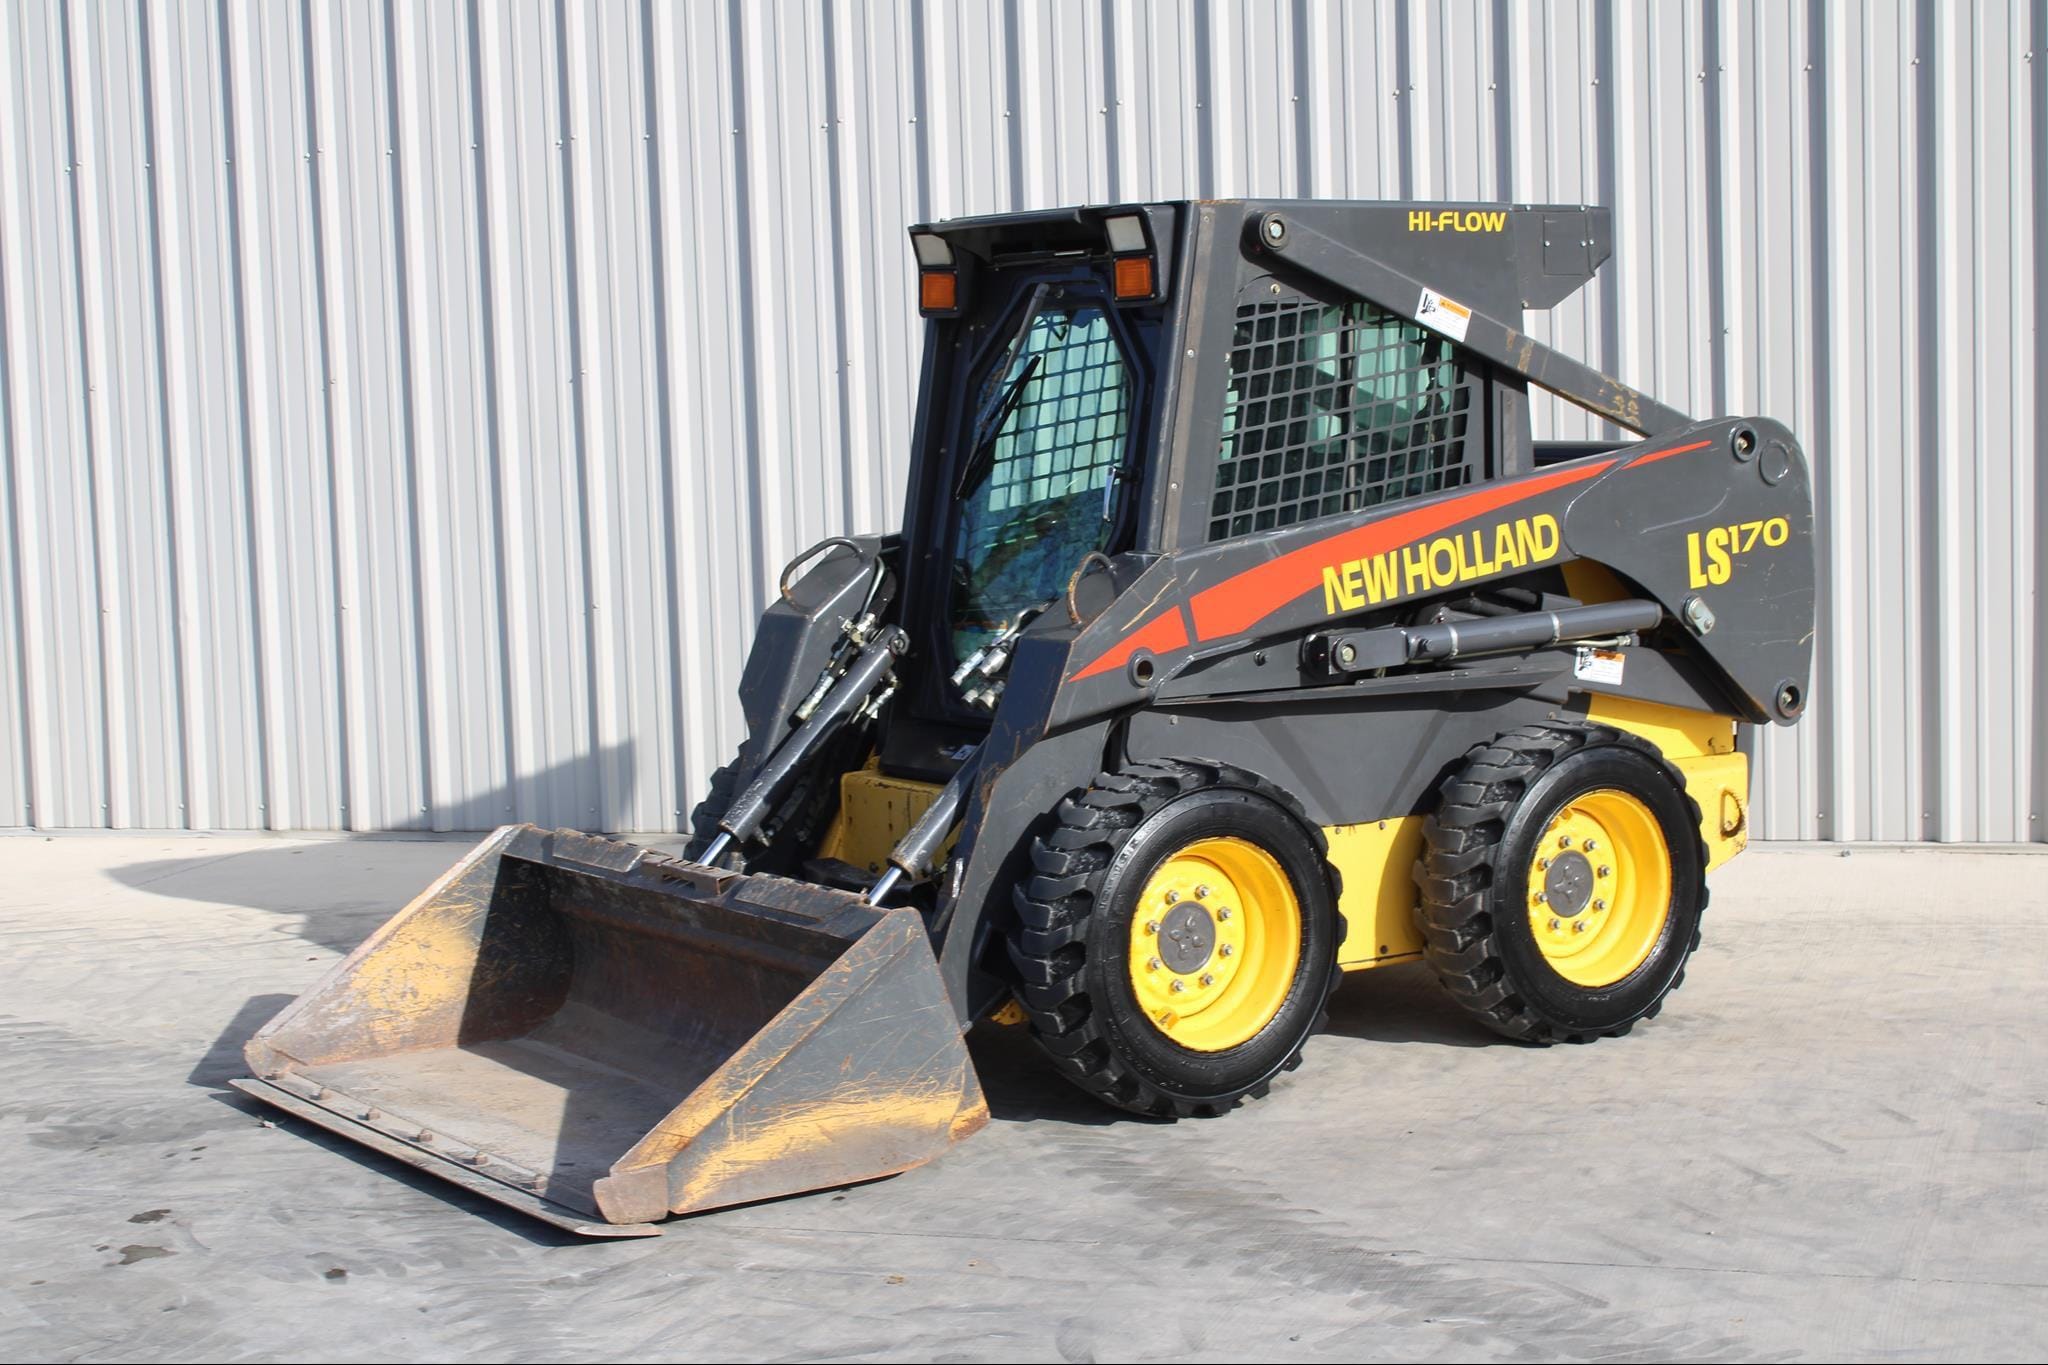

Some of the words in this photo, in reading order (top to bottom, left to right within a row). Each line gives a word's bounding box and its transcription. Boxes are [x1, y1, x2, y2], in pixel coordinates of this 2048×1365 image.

[1408, 211, 1507, 232] HI-FLOW
[1322, 550, 1399, 616] NEW
[1402, 513, 1560, 596] HOLLAND
[1687, 517, 1790, 590] LS170
